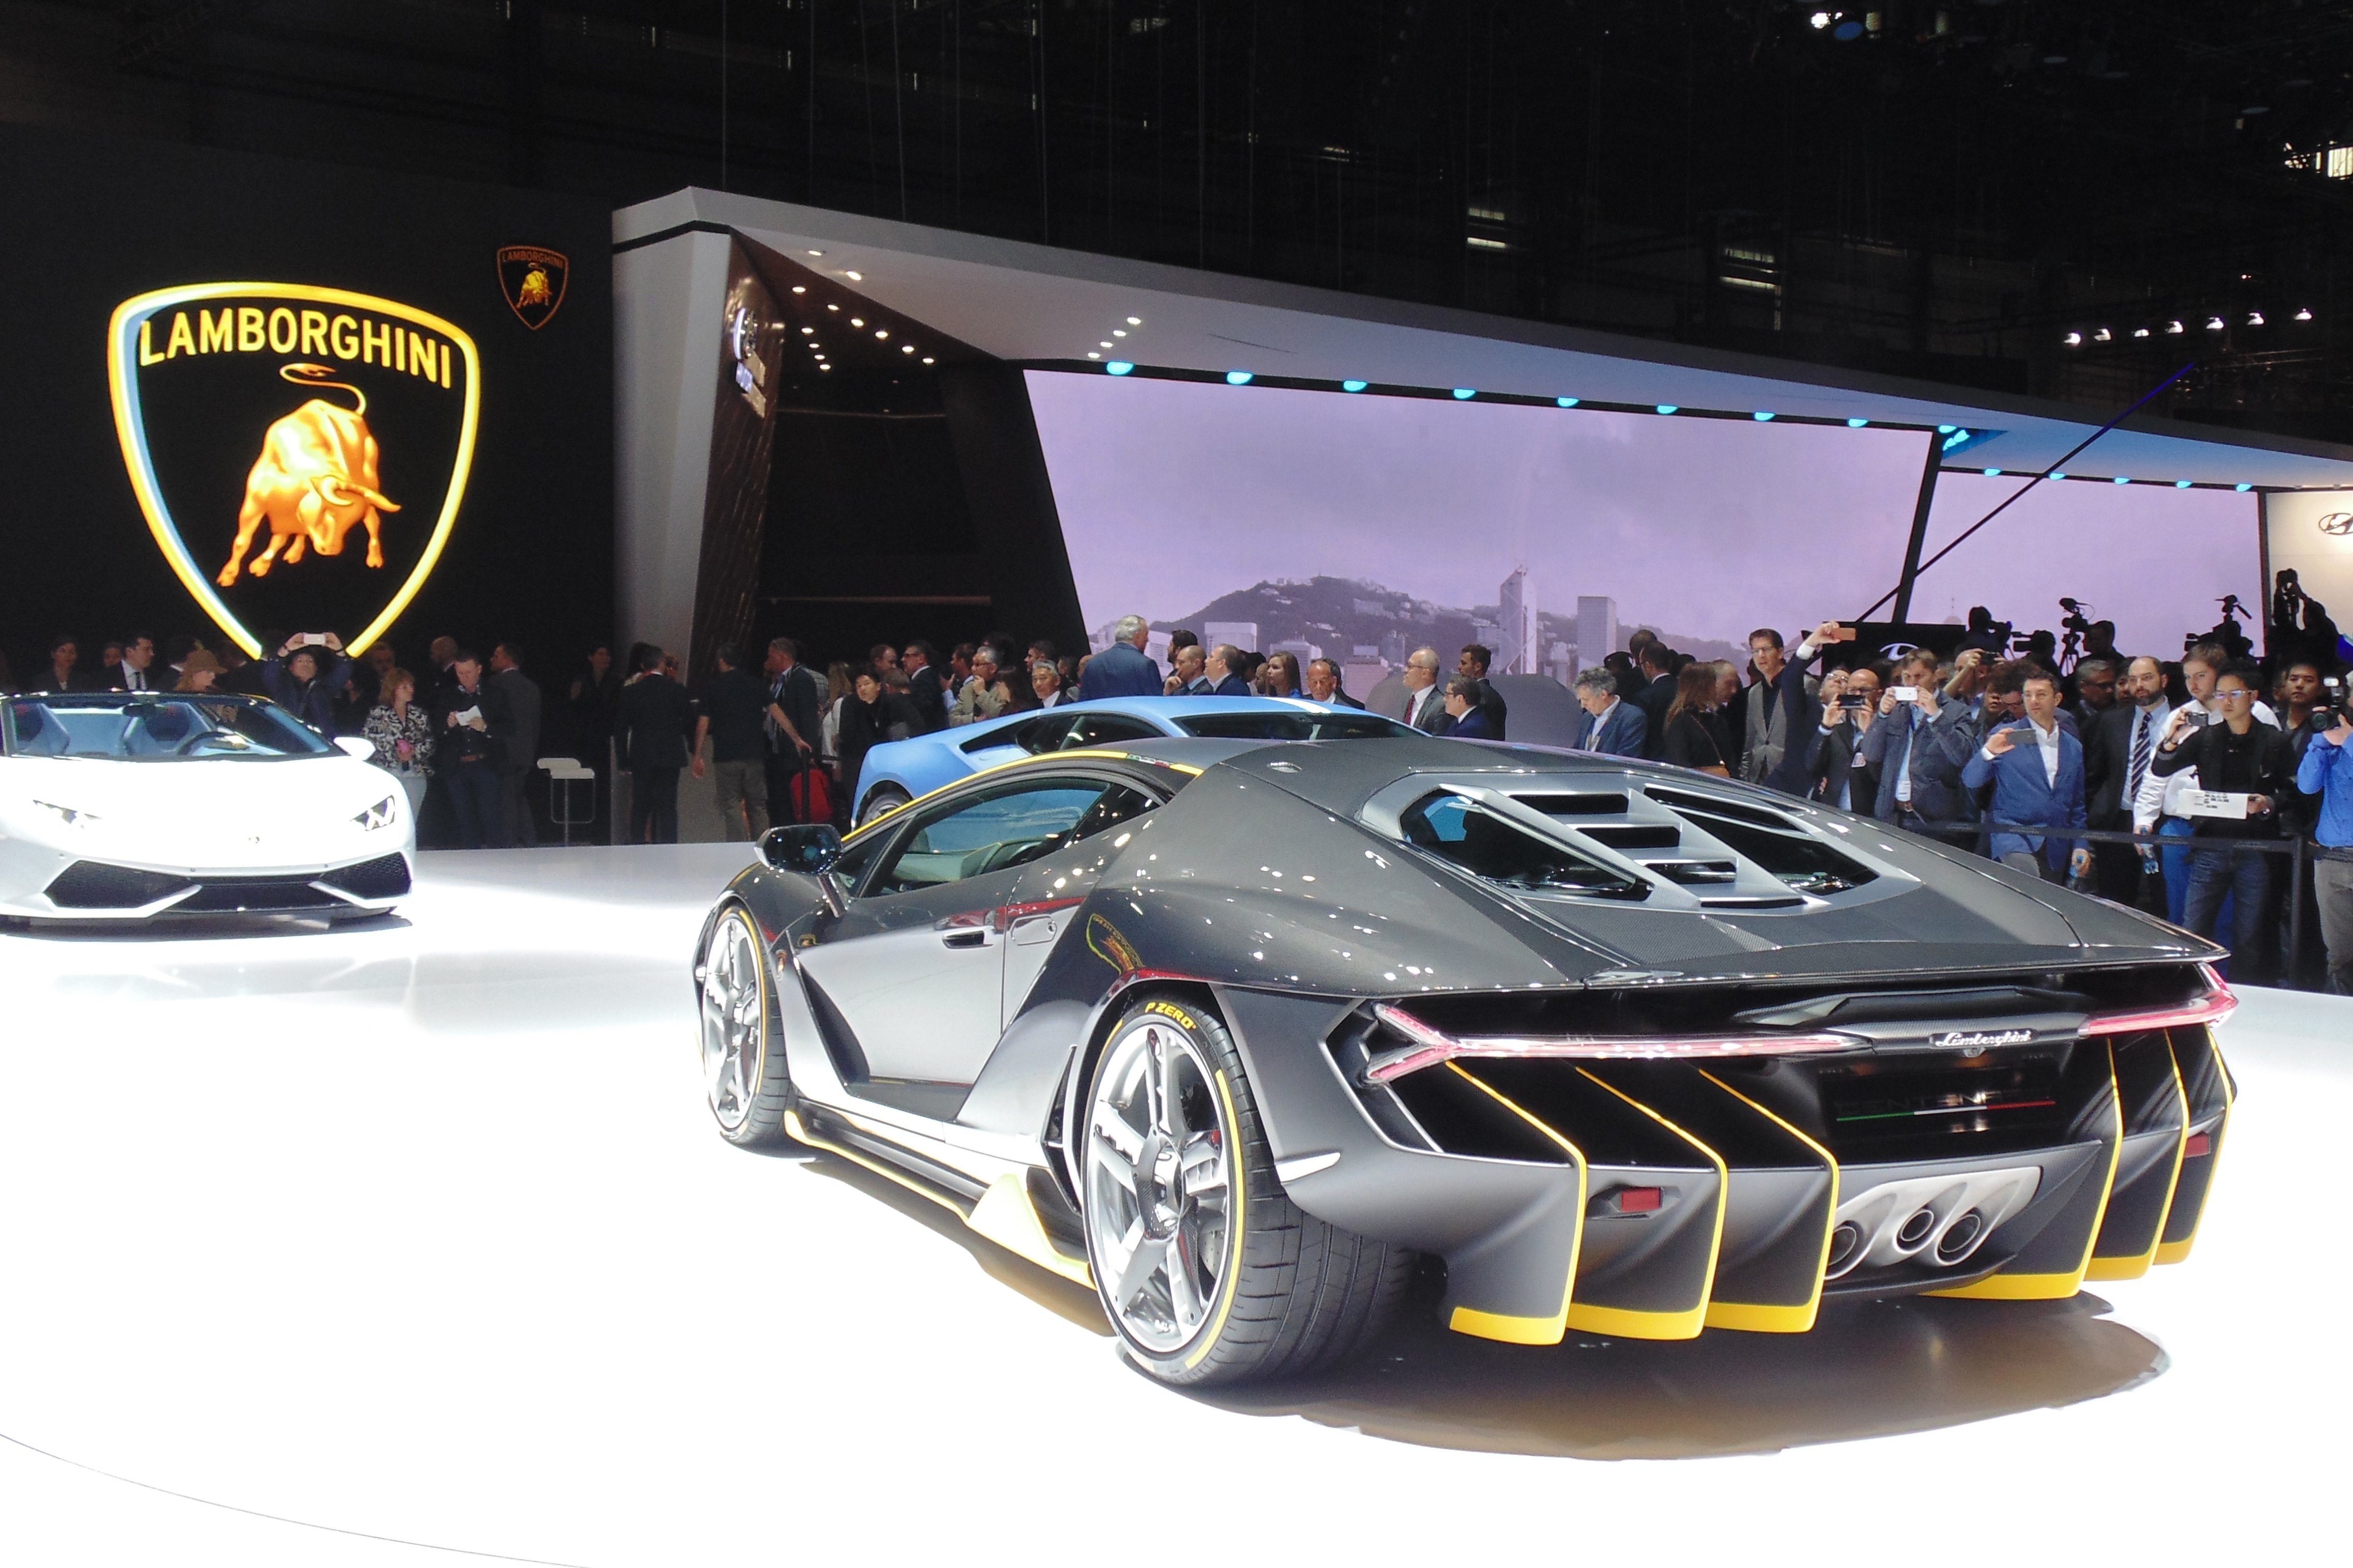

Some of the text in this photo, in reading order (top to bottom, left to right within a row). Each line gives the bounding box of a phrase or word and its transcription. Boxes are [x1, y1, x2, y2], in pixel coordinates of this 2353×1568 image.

[140, 307, 451, 389] LAMBORGHINI
[1145, 1002, 1195, 1030] P ZERO
[1935, 1030, 2031, 1047] Lamborghini
